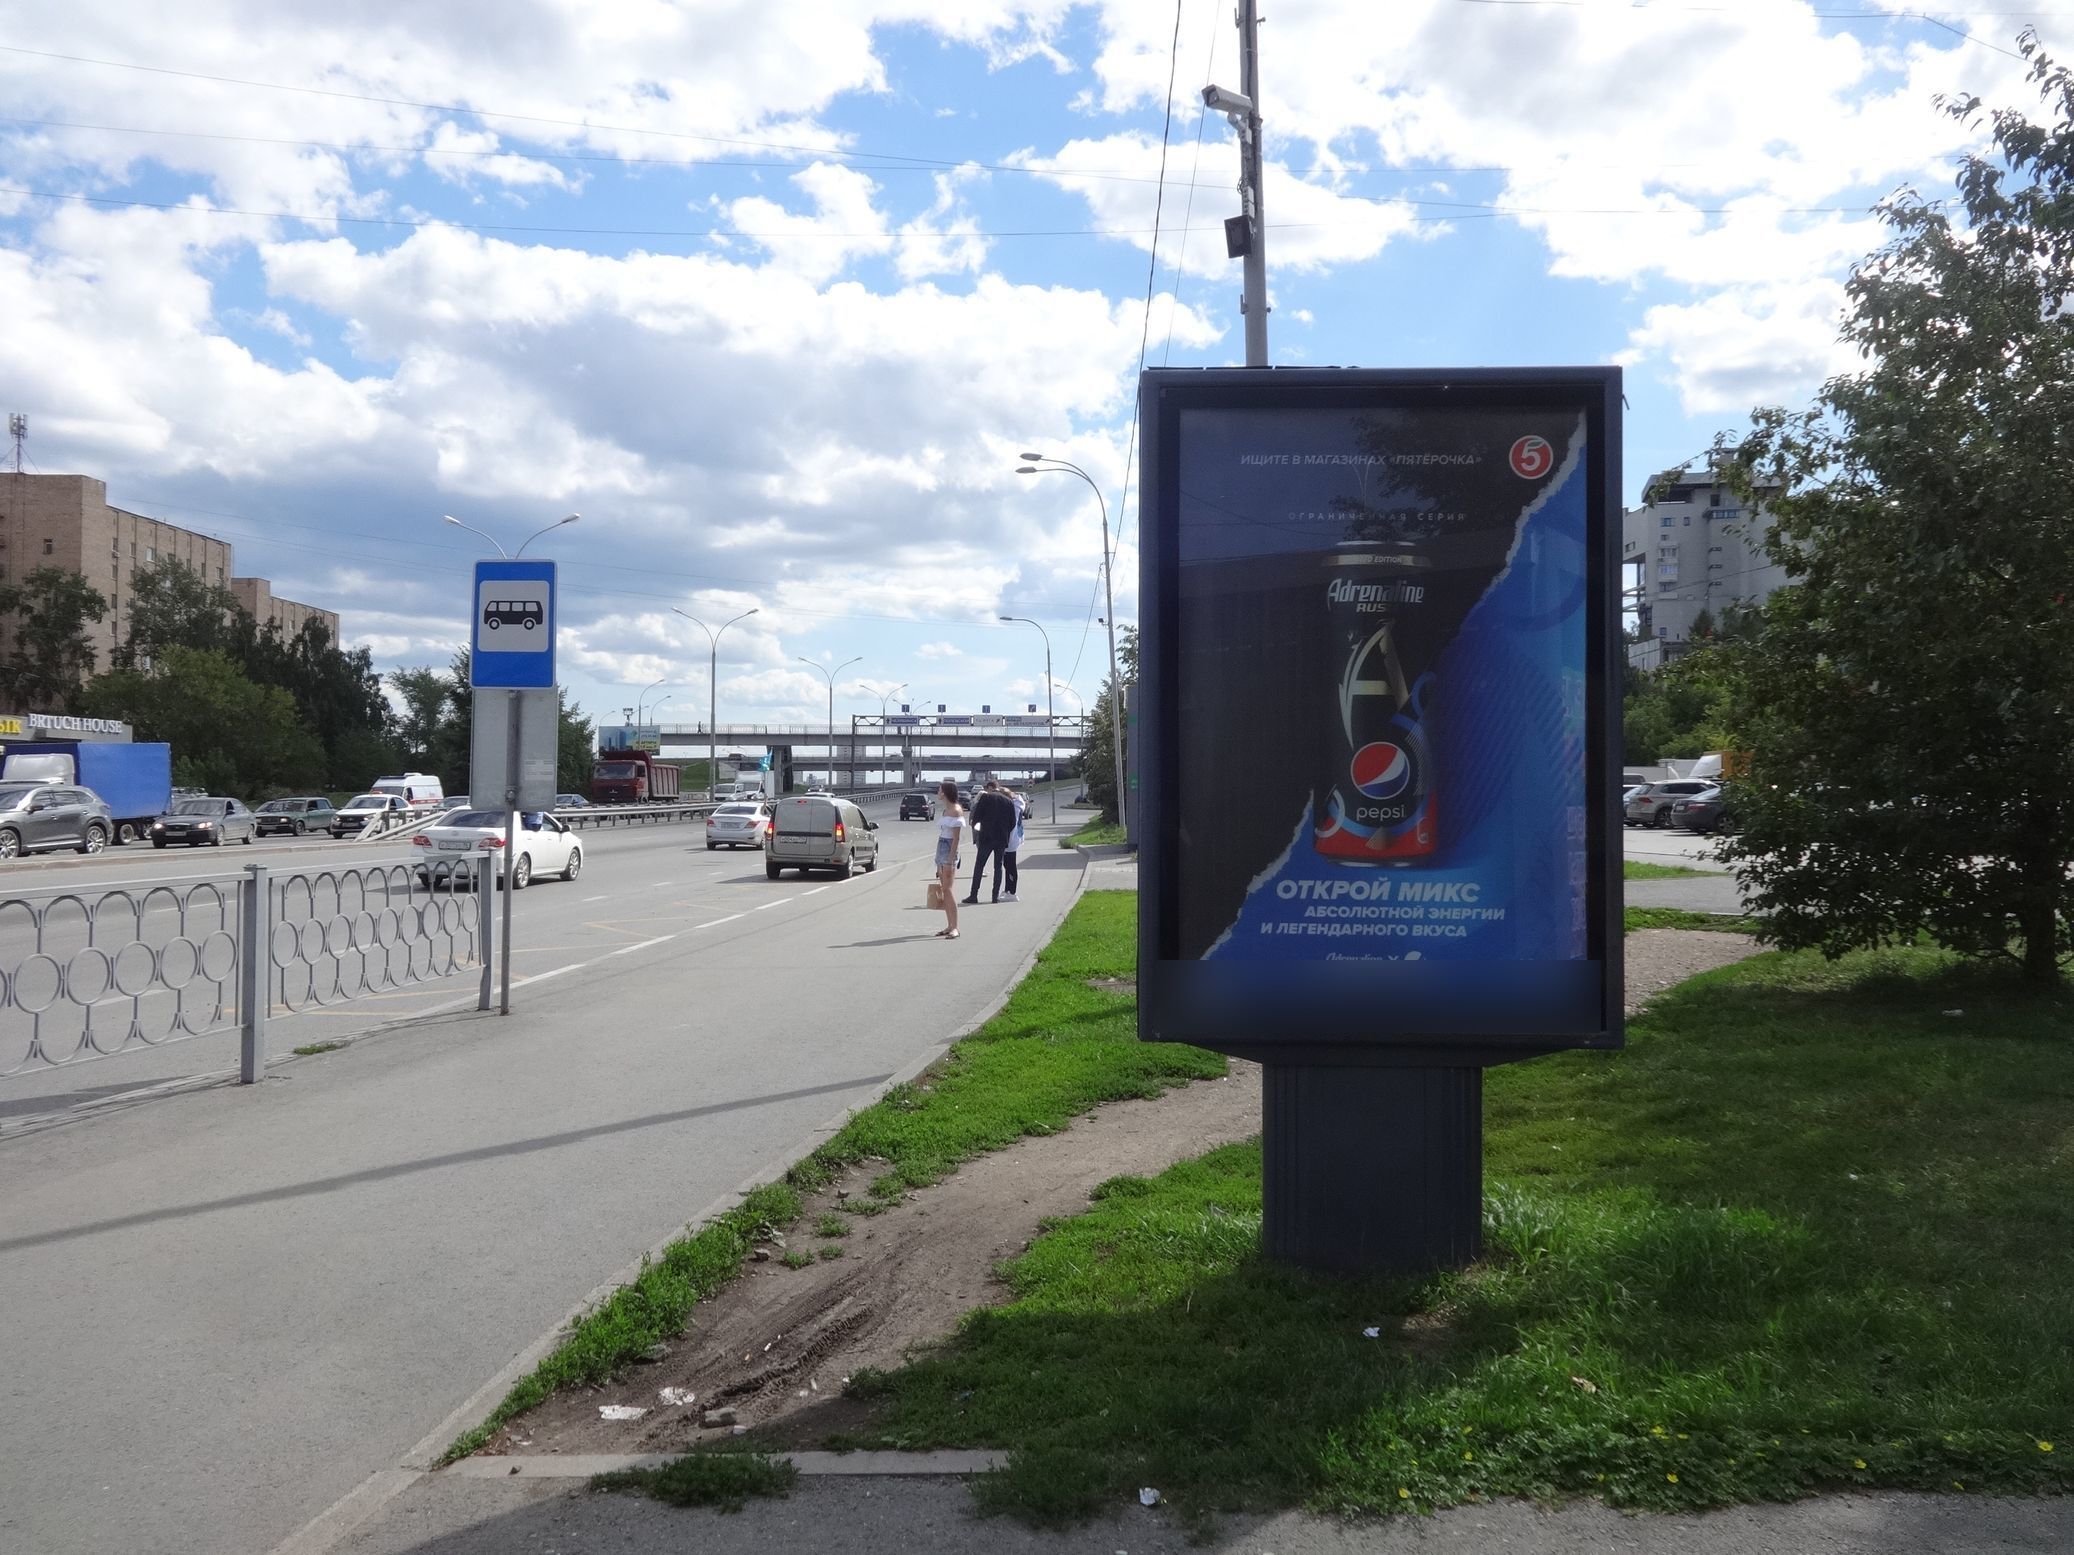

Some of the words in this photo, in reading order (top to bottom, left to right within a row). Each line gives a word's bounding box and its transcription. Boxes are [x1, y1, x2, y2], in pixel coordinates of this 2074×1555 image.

[1240, 454, 1290, 467] ИЩИТЕ
[1292, 455, 1301, 465] В
[1304, 455, 1385, 465] МАГАЗИНАХ
[1390, 453, 1482, 466] «ПЯТЁРОЧКА»
[1417, 512, 1465, 522] СЕРИЯ
[1374, 556, 1402, 564] EDITION
[1327, 577, 1425, 611] Adrenaline
[1356, 602, 1387, 613] RUS
[83, 717, 122, 733] HOUSE
[1356, 804, 1405, 821] pepsi
[1275, 877, 1391, 901] ОТКРОЙ
[1397, 881, 1481, 903] МИКС
[1303, 905, 1425, 919] АБСОЛЮТНОЙ
[1428, 907, 1505, 921] ЭНЕРГИИ
[1260, 923, 1273, 935] И
[1276, 922, 1409, 937] ЛЕГЕНДАРНОГО
[1411, 924, 1467, 937] ВКУСА
